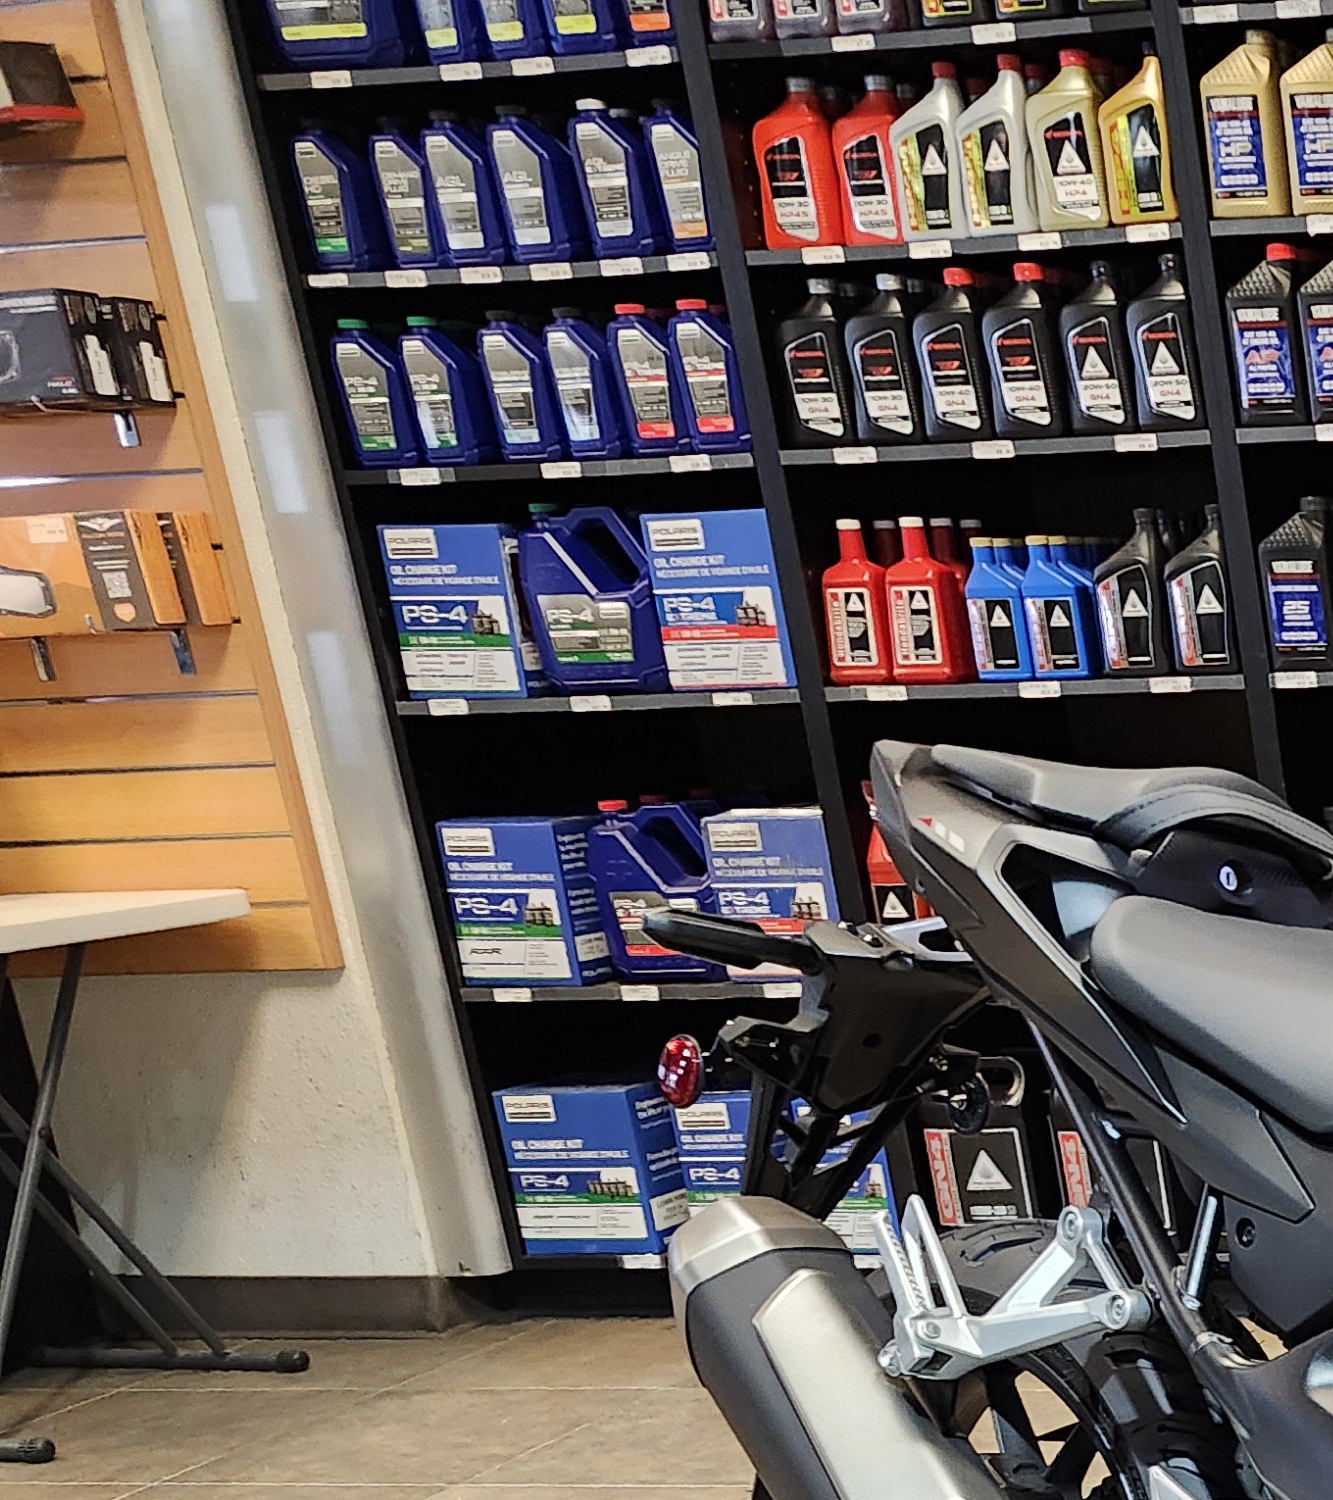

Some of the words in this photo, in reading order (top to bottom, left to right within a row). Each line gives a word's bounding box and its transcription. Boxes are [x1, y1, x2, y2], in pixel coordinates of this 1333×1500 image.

[663, 597, 716, 613] PS-4
[401, 604, 469, 624] PS-4
[454, 897, 519, 915] PS-4
[719, 891, 770, 906] PS-4
[521, 1174, 570, 1188] PS-4
[689, 1167, 741, 1182] PS-4
